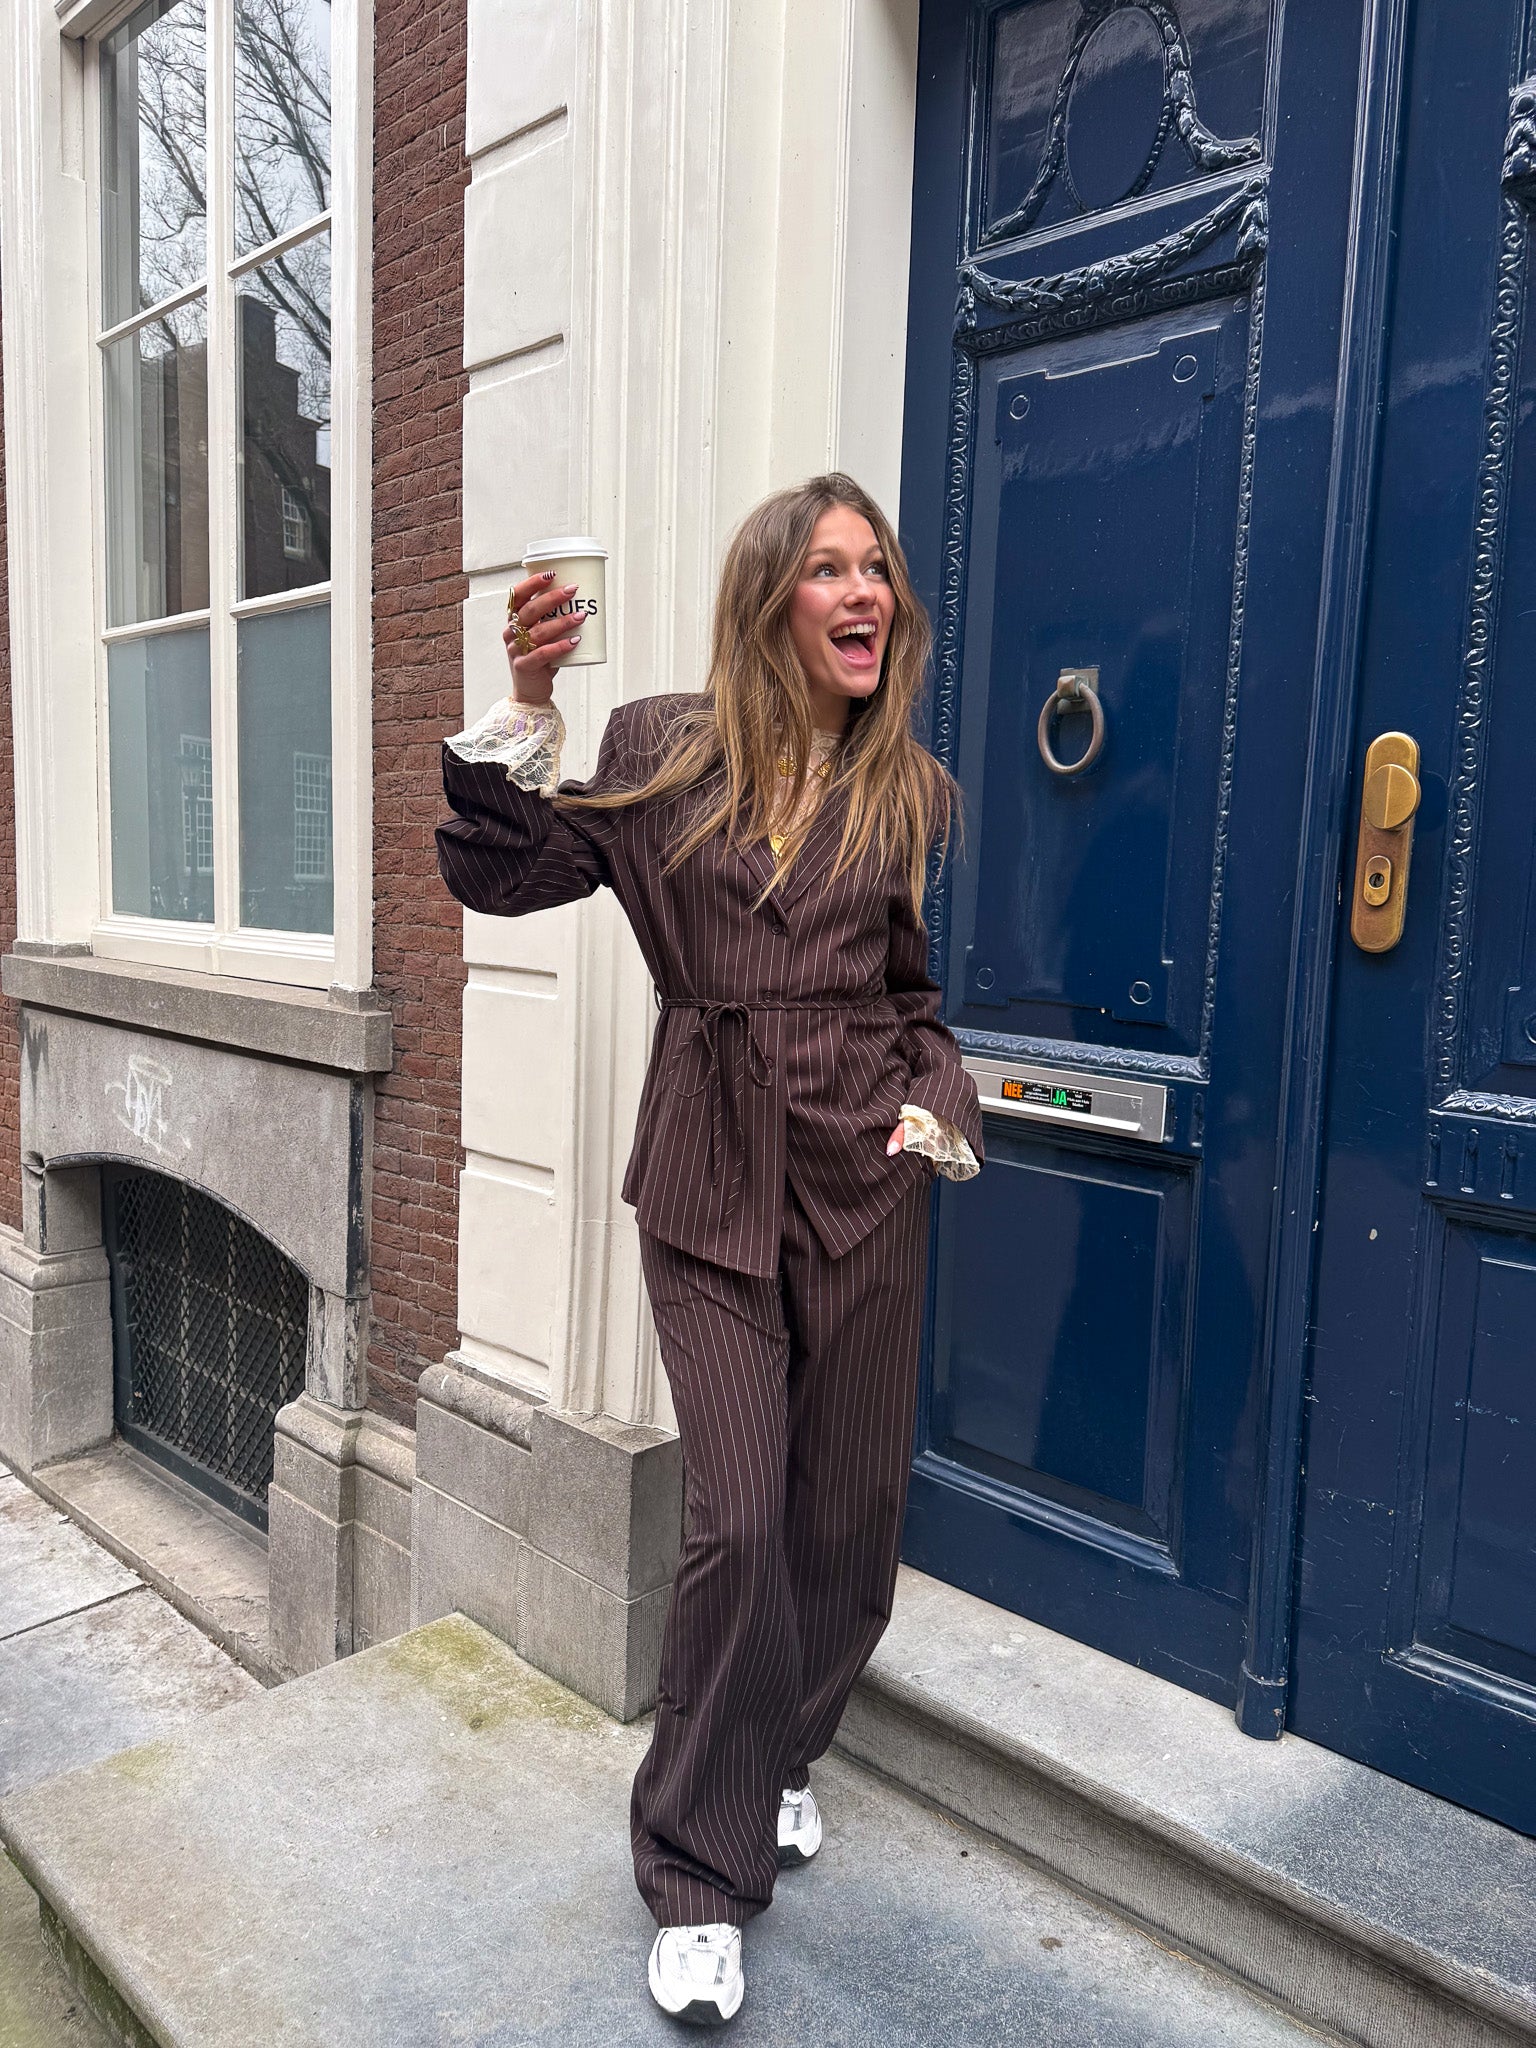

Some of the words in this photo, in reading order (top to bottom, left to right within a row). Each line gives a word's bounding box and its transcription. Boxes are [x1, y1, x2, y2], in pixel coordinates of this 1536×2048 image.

[541, 598, 598, 619] QUES
[1004, 1082, 1023, 1098] NEE
[1053, 1090, 1067, 1105] JA
